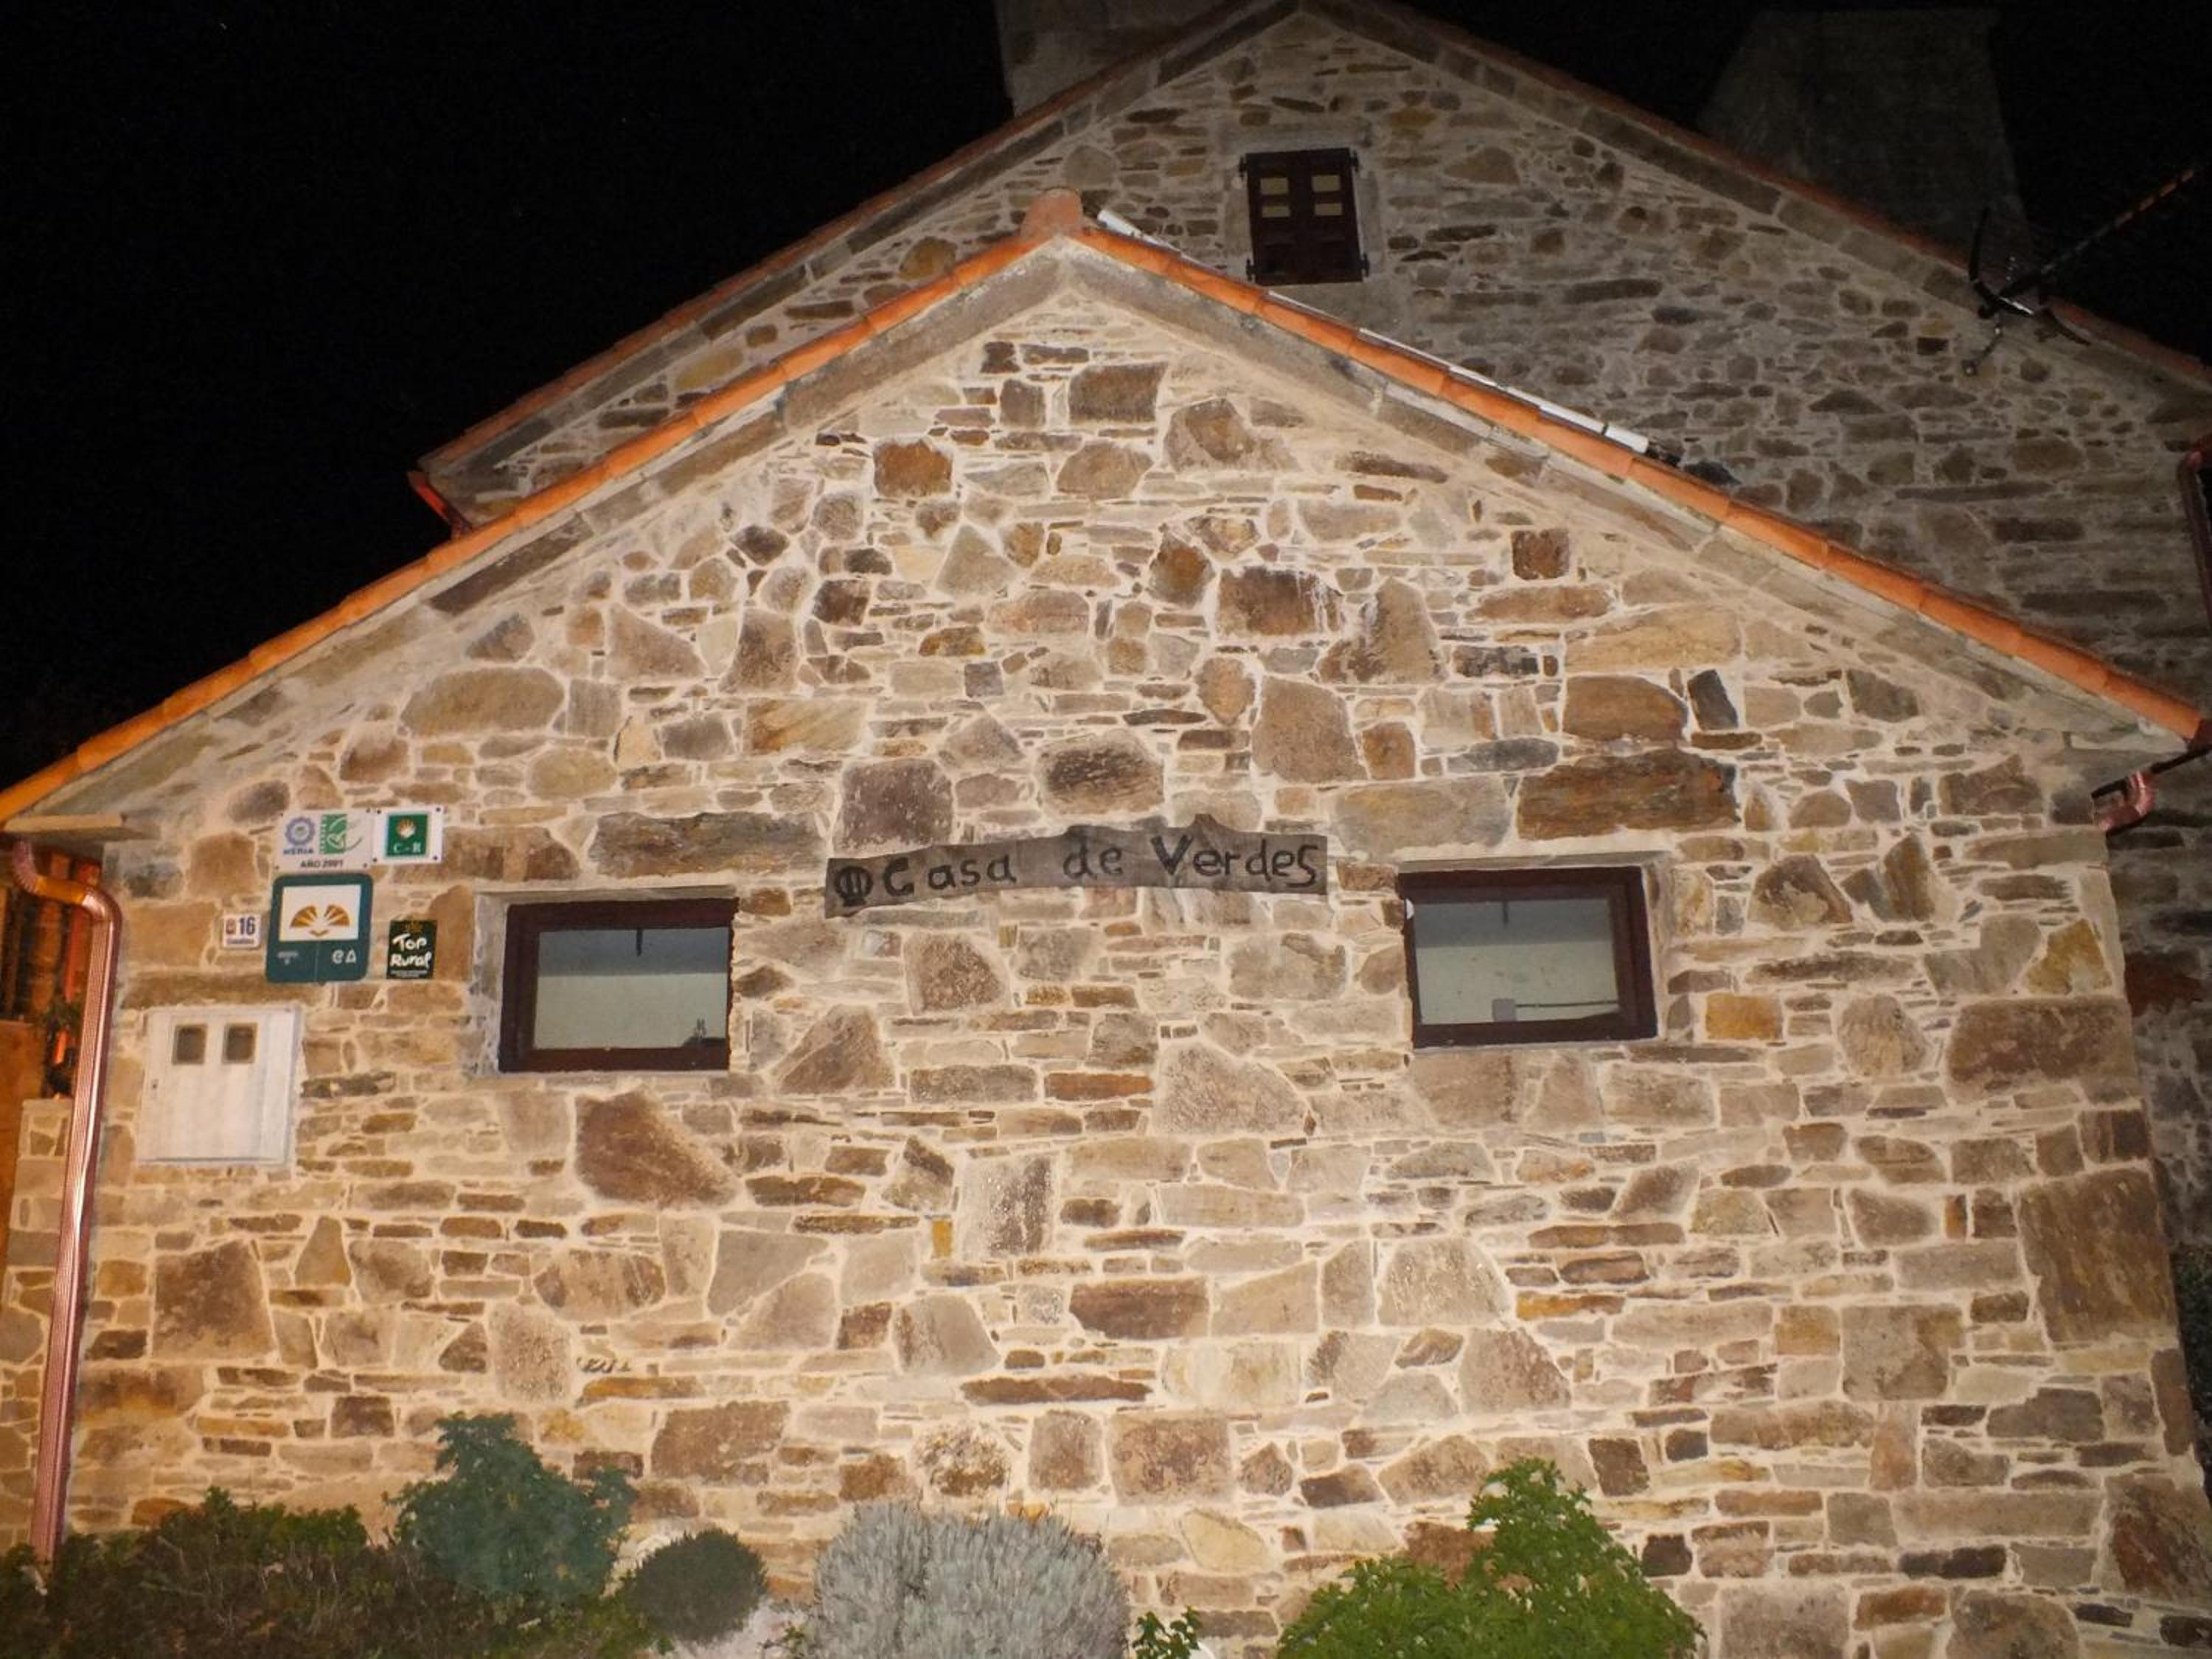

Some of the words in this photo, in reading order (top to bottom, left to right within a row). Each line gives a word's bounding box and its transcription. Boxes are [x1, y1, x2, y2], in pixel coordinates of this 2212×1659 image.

[883, 854, 1018, 897] Casa
[1062, 835, 1124, 880] de
[1150, 834, 1320, 888] Verdes
[240, 916, 256, 936] 16
[389, 951, 433, 970] Rural
